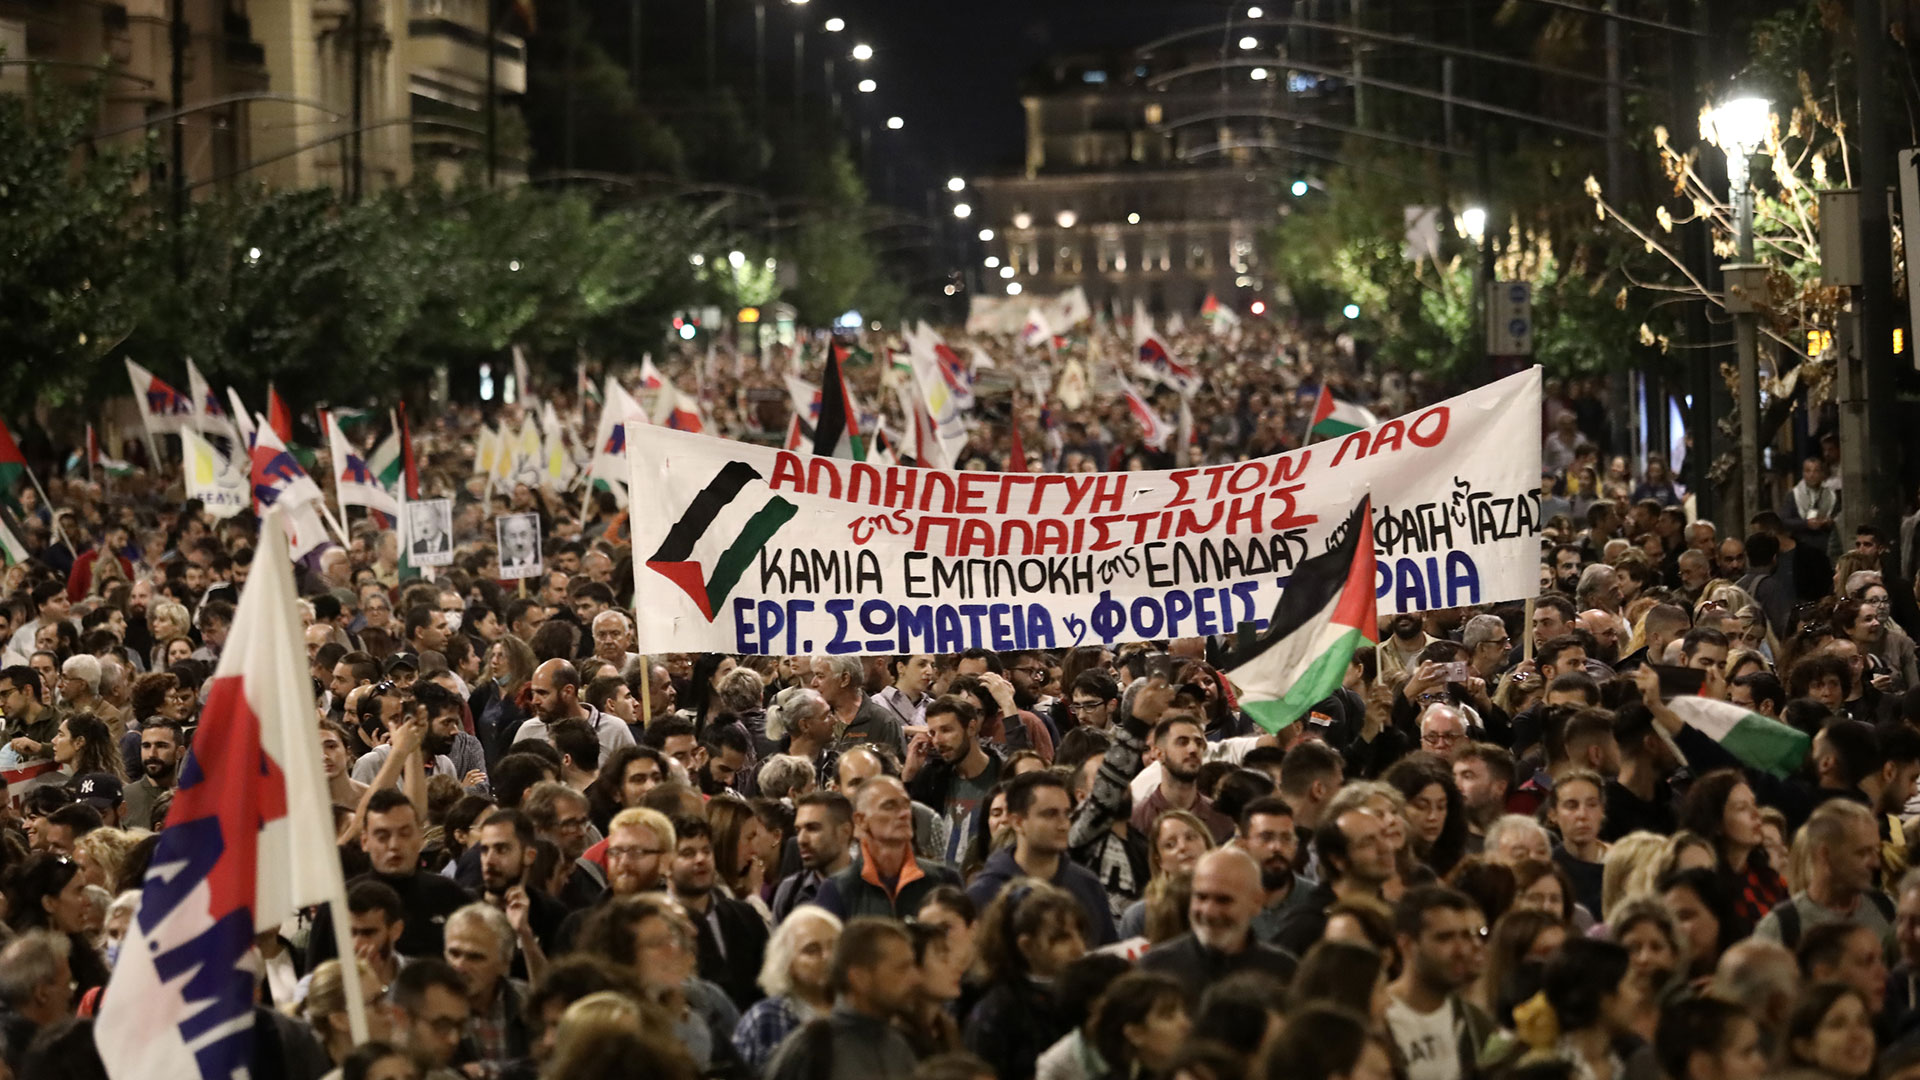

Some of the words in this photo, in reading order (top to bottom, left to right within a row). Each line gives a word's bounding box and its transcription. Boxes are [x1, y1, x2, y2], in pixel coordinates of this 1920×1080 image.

[770, 451, 1128, 515] ΑΛΛΗΛΕΓΓΥΗ
[1164, 450, 1311, 508] ΣΤΟΝ
[1330, 406, 1450, 467] ΛΑΟ
[760, 546, 883, 595] ΚΑΜΙΑ
[904, 551, 1093, 599] ΕΜΠΛΟΚΗ
[1371, 502, 1453, 556] ΦΑΓΗ
[914, 483, 1318, 557] ΠΑΛΑΙΣΤΙΝΗΣ
[733, 597, 813, 655] ΕΡΓ.
[825, 598, 1056, 655] ΣΩΜΑΤΕΙΑ
[1090, 580, 1268, 644] ΦΟΡΕΙΣ
